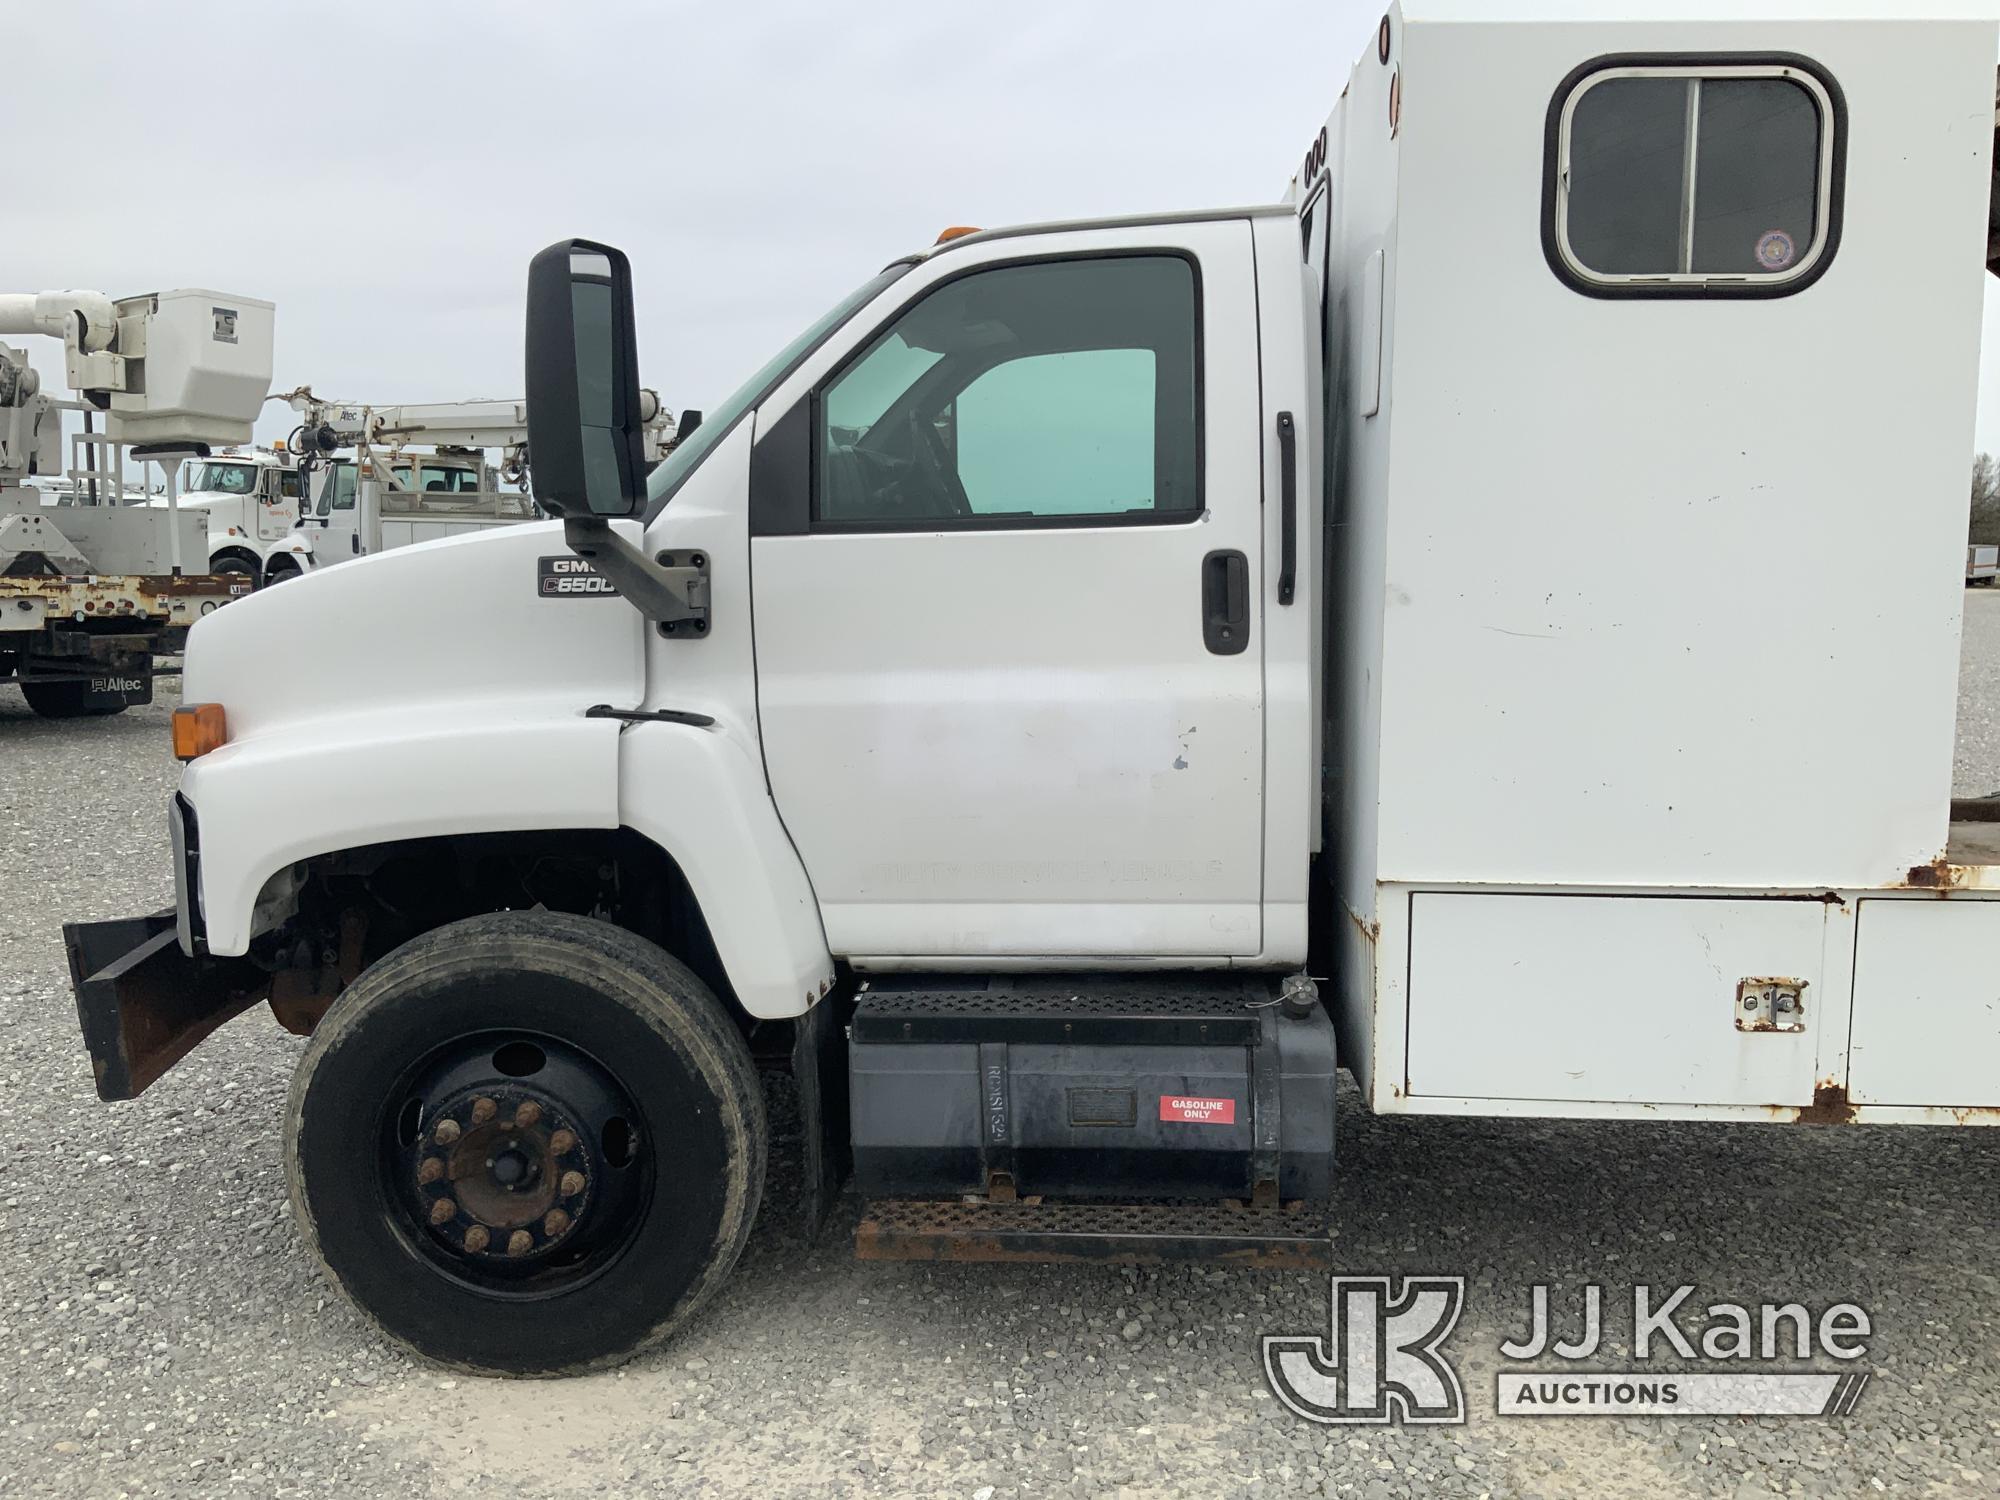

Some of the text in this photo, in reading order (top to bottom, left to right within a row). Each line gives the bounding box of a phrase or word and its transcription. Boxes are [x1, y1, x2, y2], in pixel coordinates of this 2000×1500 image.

[340, 410, 358, 421] Altec
[553, 560, 597, 573] GM
[107, 677, 142, 691] Altec
[1171, 1099, 1224, 1111] GASOLINE
[1183, 1109, 1211, 1119] ONLY
